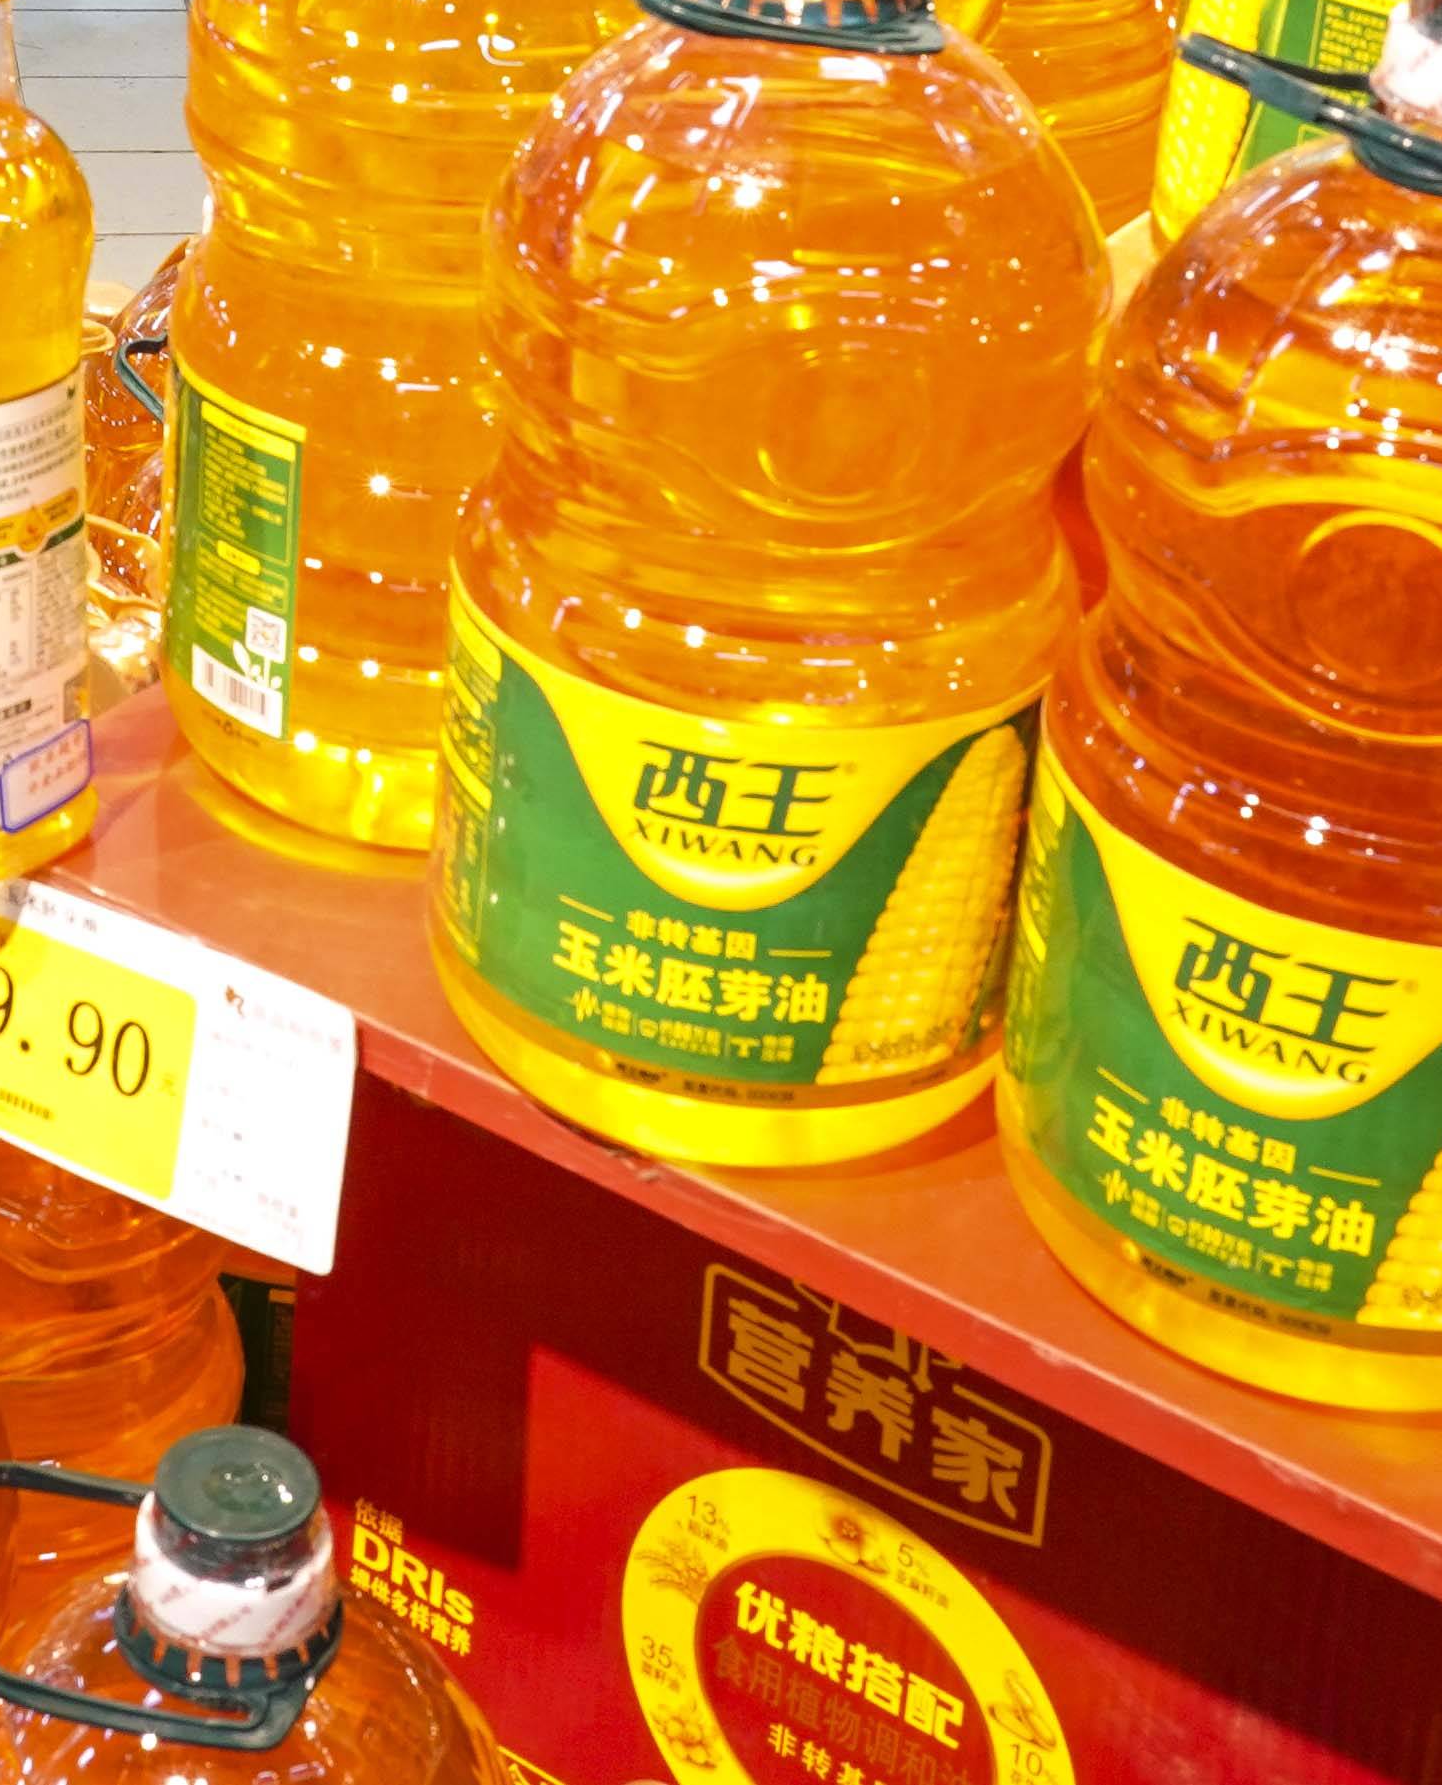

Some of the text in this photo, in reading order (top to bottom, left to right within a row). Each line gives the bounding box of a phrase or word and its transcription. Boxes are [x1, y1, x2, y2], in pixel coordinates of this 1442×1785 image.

[633, 740, 839, 837] 西王
[633, 818, 818, 868] XIWANG
[553, 921, 829, 1024] 玉米胚芽油
[627, 910, 756, 962] 非转基因
[1174, 918, 1399, 1052] 西王
[1170, 1001, 1373, 1085] XIWANG
[1088, 1095, 1375, 1257] 玉米胚芽油
[1161, 1097, 1296, 1176] 非转基因
[723, 1304, 1025, 1523] 营养家
[351, 1525, 475, 1625] DRIs
[735, 1582, 966, 1750] 优粮搭配
